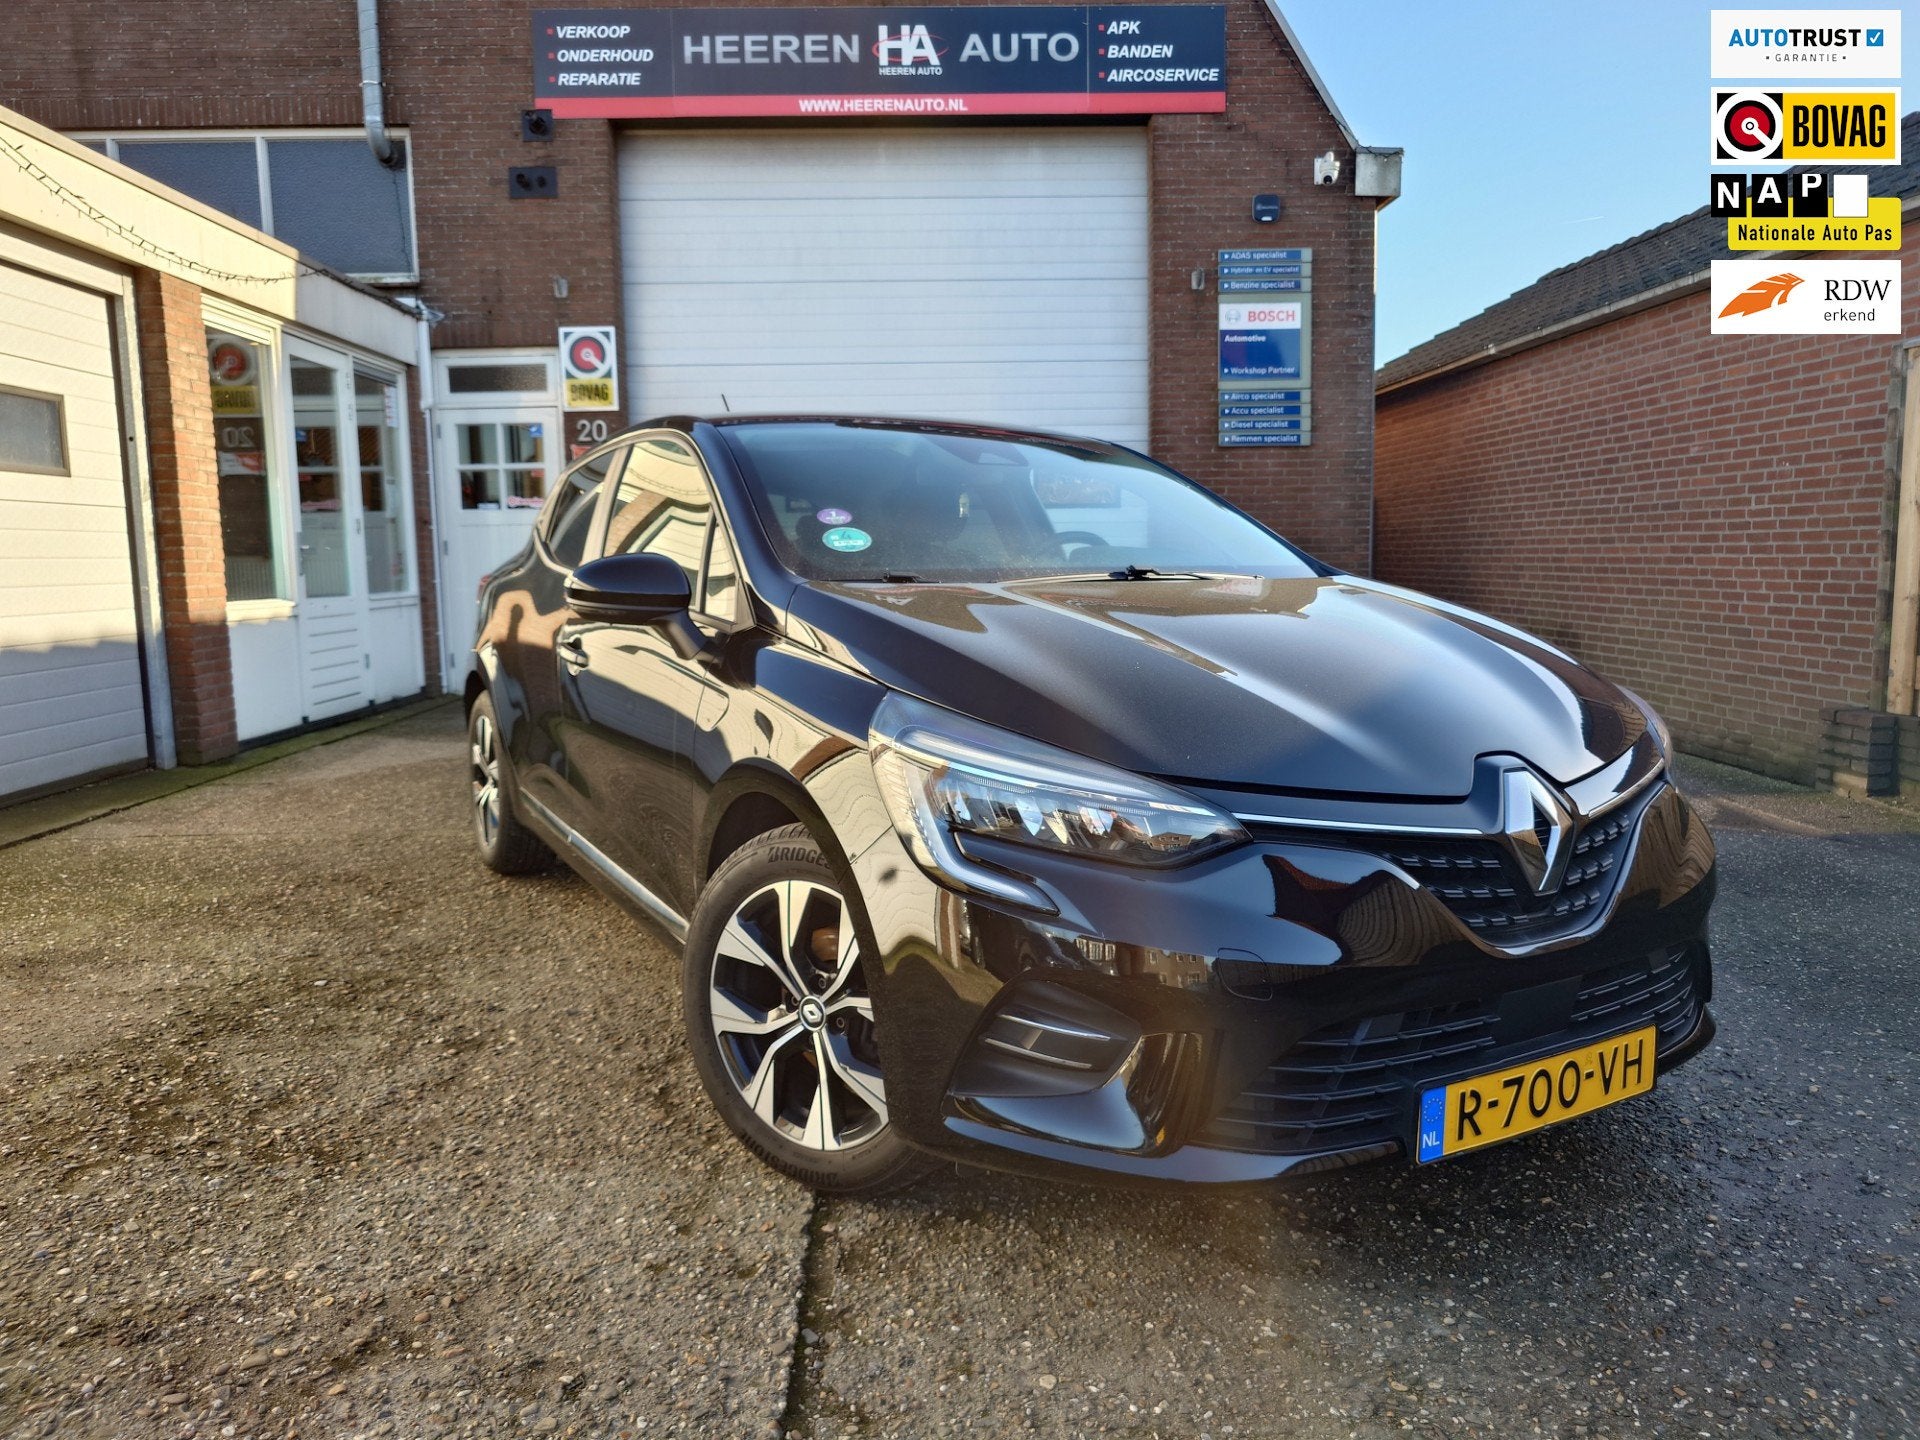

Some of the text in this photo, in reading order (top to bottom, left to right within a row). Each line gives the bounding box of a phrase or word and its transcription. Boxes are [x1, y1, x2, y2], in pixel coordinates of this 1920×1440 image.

[556, 25, 631, 39] VERKOOP
[1107, 21, 1141, 35] APK
[684, 32, 1080, 65] HEEREN AUTO
[878, 24, 941, 66] HA
[1107, 45, 1173, 59] BANDEN
[557, 49, 654, 63] ONDERHOUD
[879, 67, 943, 76] HEEREN AUTO
[1107, 68, 1219, 83] AIRCOSERVICE
[558, 73, 641, 87] REPARATIE
[799, 98, 968, 112] WWW.HEERENAUTO.NL
[1231, 251, 1287, 260] ADAS specialist
[1230, 281, 1295, 290] Benzine specialist
[1248, 310, 1296, 322] BOSCH
[1224, 334, 1266, 342] Automotive
[1231, 366, 1295, 375] Workshop Partner
[1251, 393, 1285, 401] specialist
[1250, 406, 1284, 415] specialist
[576, 419, 608, 442] 20
[1255, 420, 1288, 429] specialist
[1231, 435, 1298, 443] Remmen specialist
[1457, 1037, 1643, 1141] R-700-VH
[1422, 1132, 1440, 1149] NL
